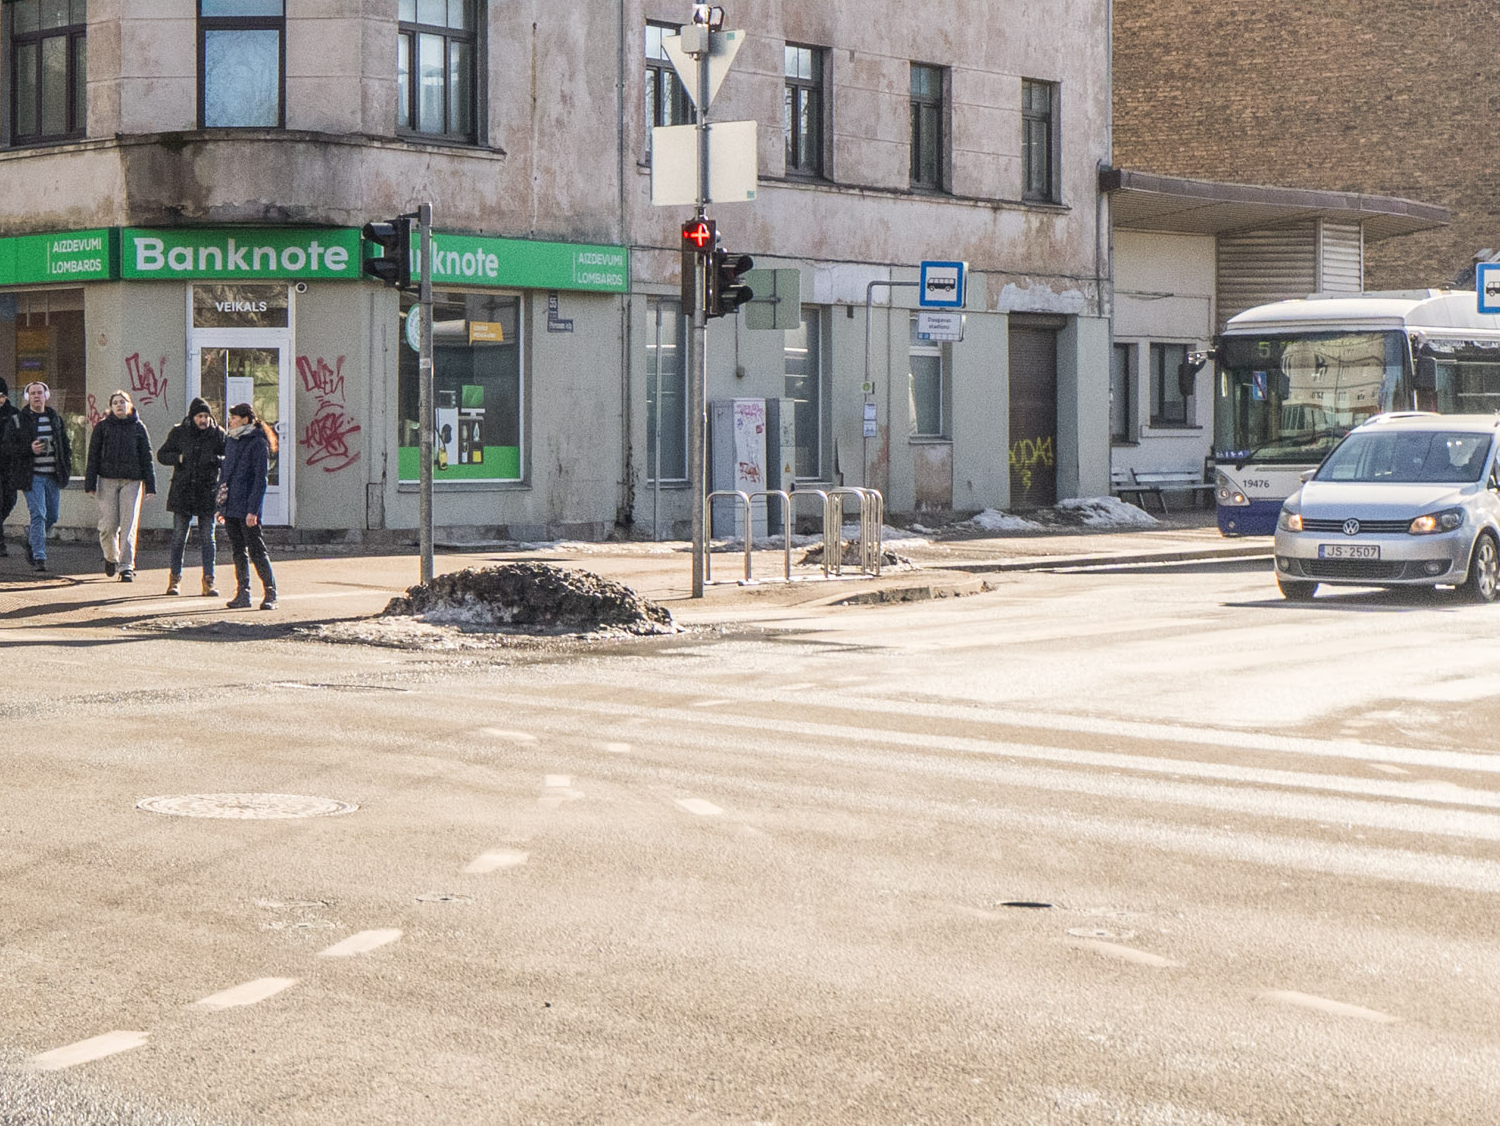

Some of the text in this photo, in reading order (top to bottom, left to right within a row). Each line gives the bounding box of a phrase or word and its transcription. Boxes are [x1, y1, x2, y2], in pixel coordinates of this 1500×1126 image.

[52, 237, 102, 253] AIZDEVUMI
[133, 237, 349, 271] Banknote
[578, 253, 623, 266] AIZDEVUMI
[52, 259, 102, 274] LOMBARDS
[577, 272, 623, 286] LOMBARDS
[215, 301, 267, 312] VEIKALS
[1258, 341, 1271, 358] 5
[1243, 479, 1270, 489] 19476
